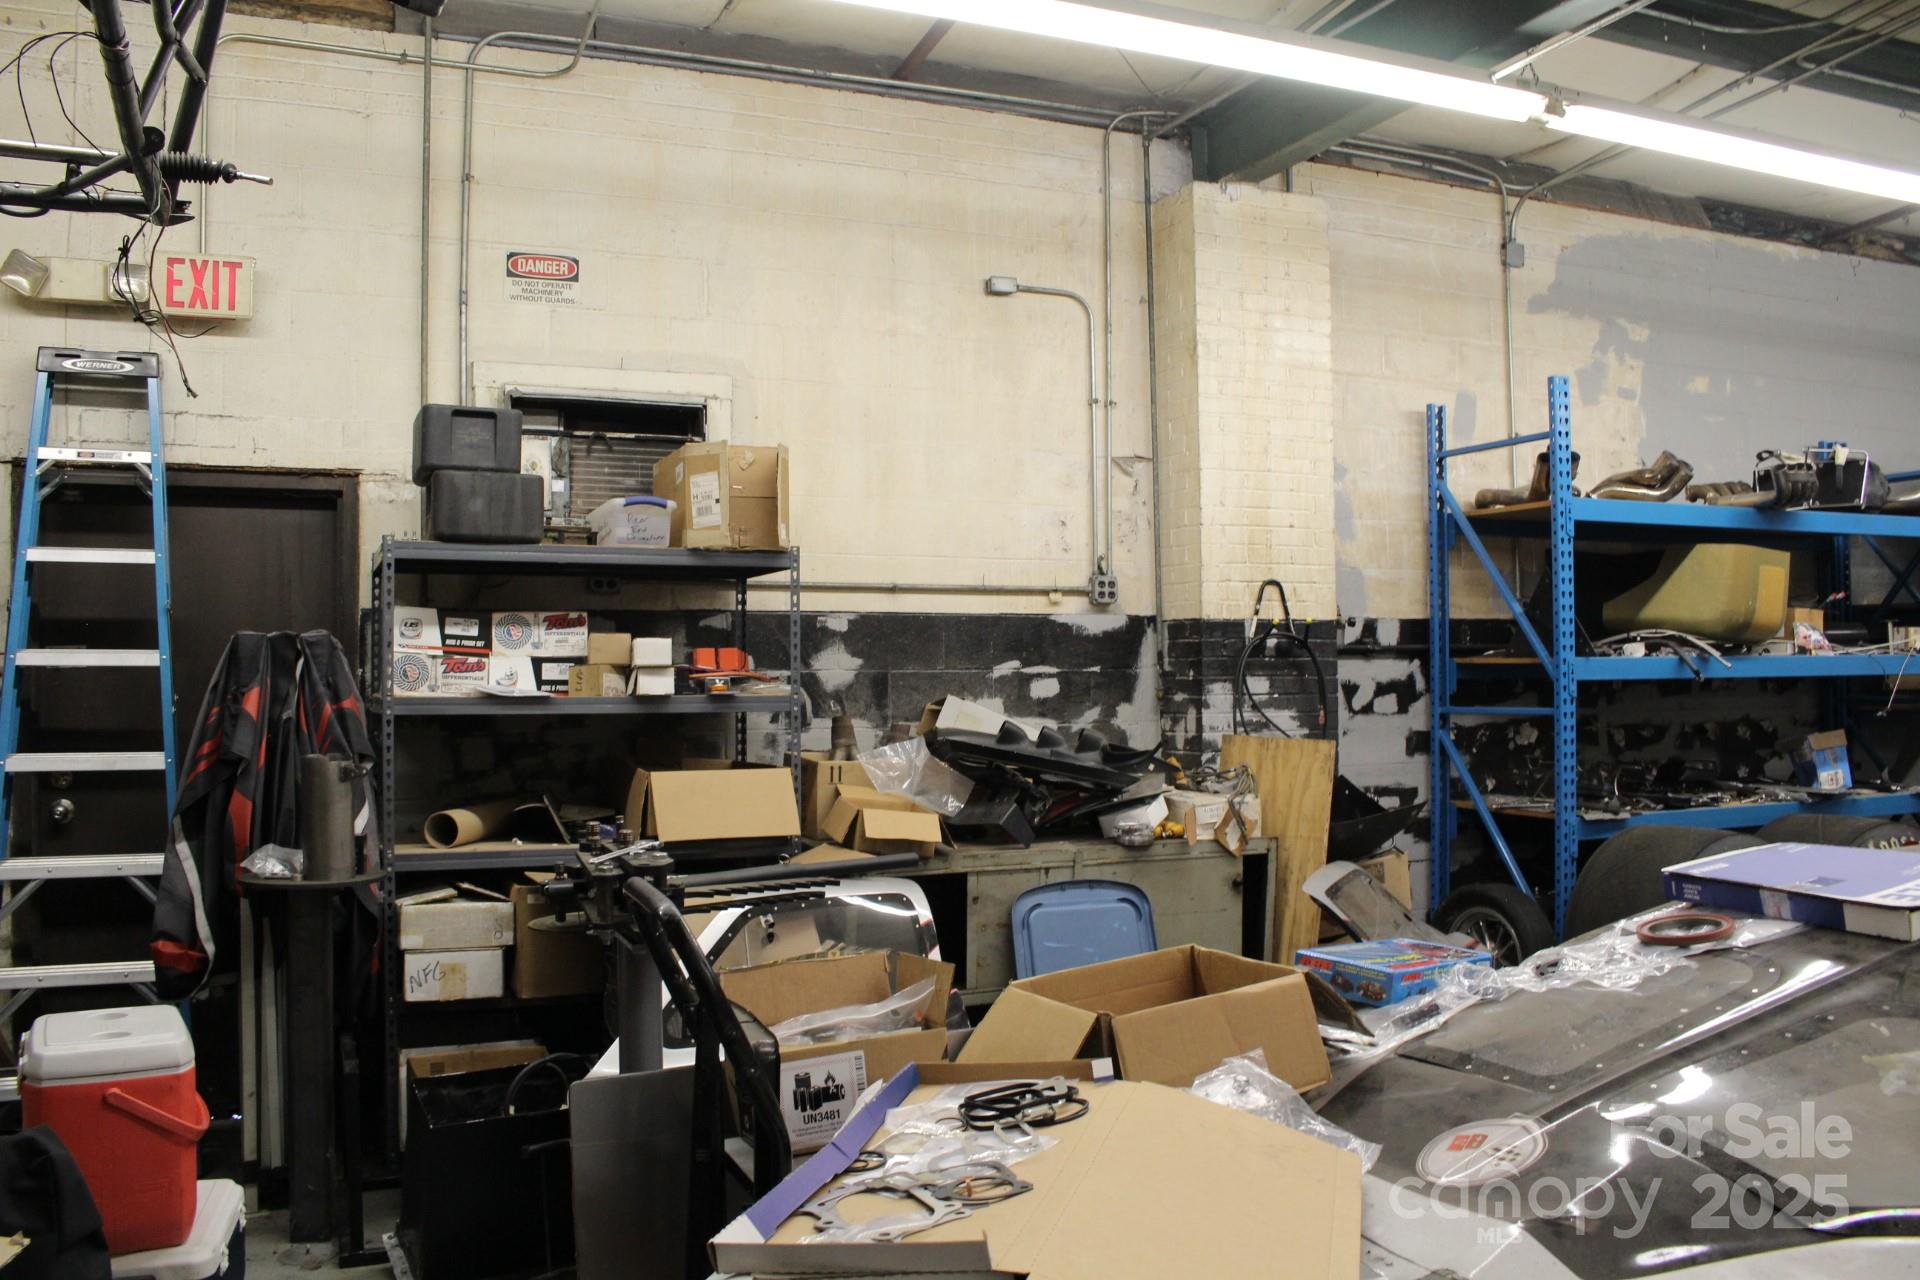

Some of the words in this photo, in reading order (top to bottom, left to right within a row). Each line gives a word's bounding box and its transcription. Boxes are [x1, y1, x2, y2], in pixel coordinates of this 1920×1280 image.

[517, 257, 568, 275] DANGER
[166, 257, 243, 311] EXIT
[521, 288, 563, 296] MACHINERY
[525, 280, 539, 288] NOT
[541, 281, 572, 290] OPERATE
[509, 294, 543, 302] WITHOUT
[76, 361, 121, 369] WERNER
[542, 613, 586, 631] Tom's
[441, 658, 486, 674] Tom's
[803, 1109, 841, 1125] UN3481
